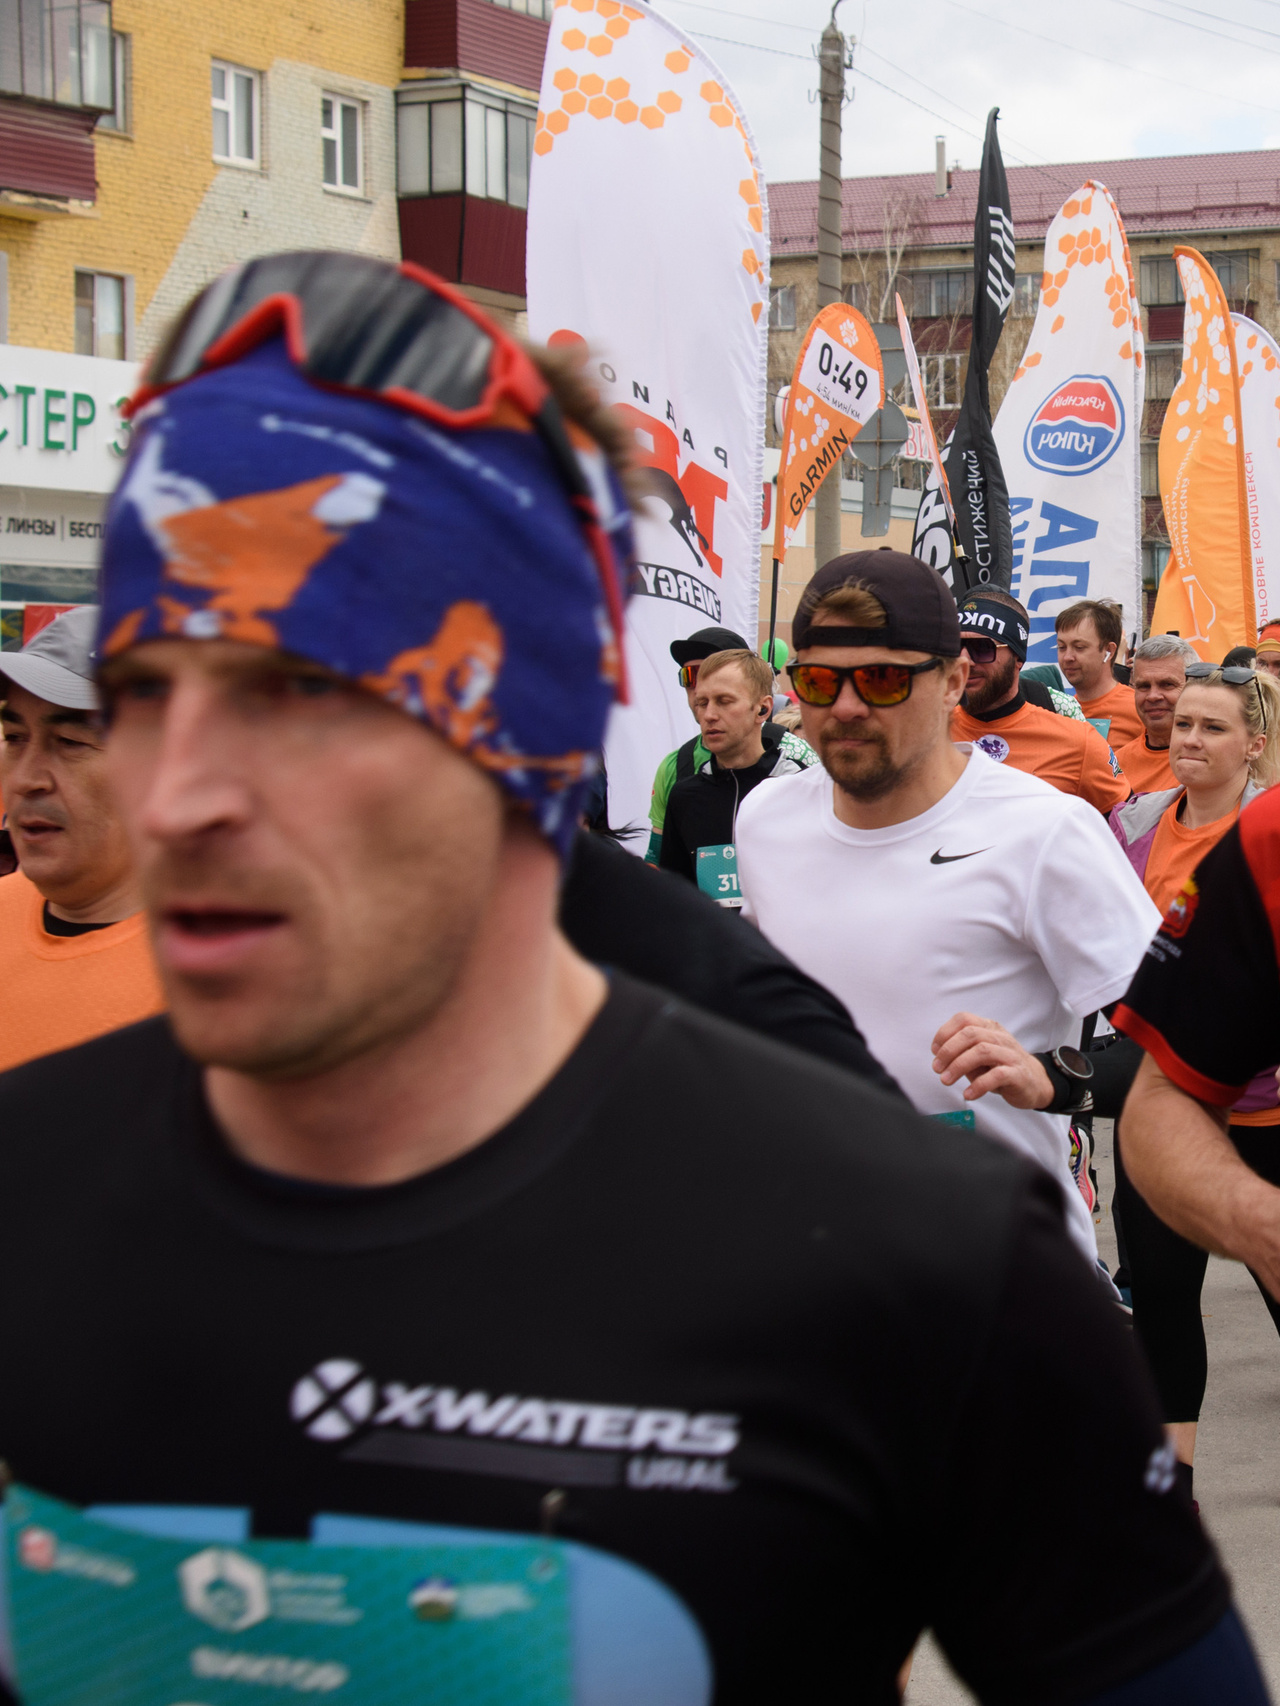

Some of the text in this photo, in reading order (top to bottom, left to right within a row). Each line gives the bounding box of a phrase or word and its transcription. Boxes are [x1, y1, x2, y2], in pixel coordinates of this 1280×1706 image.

[818, 342, 868, 401] 0:49
[789, 427, 850, 517] GARMIN
[6, 517, 56, 536] ЛИНЗЫ
[967, 450, 991, 584] остижений
[718, 873, 740, 891] 31
[627, 1457, 739, 1492] URAL
